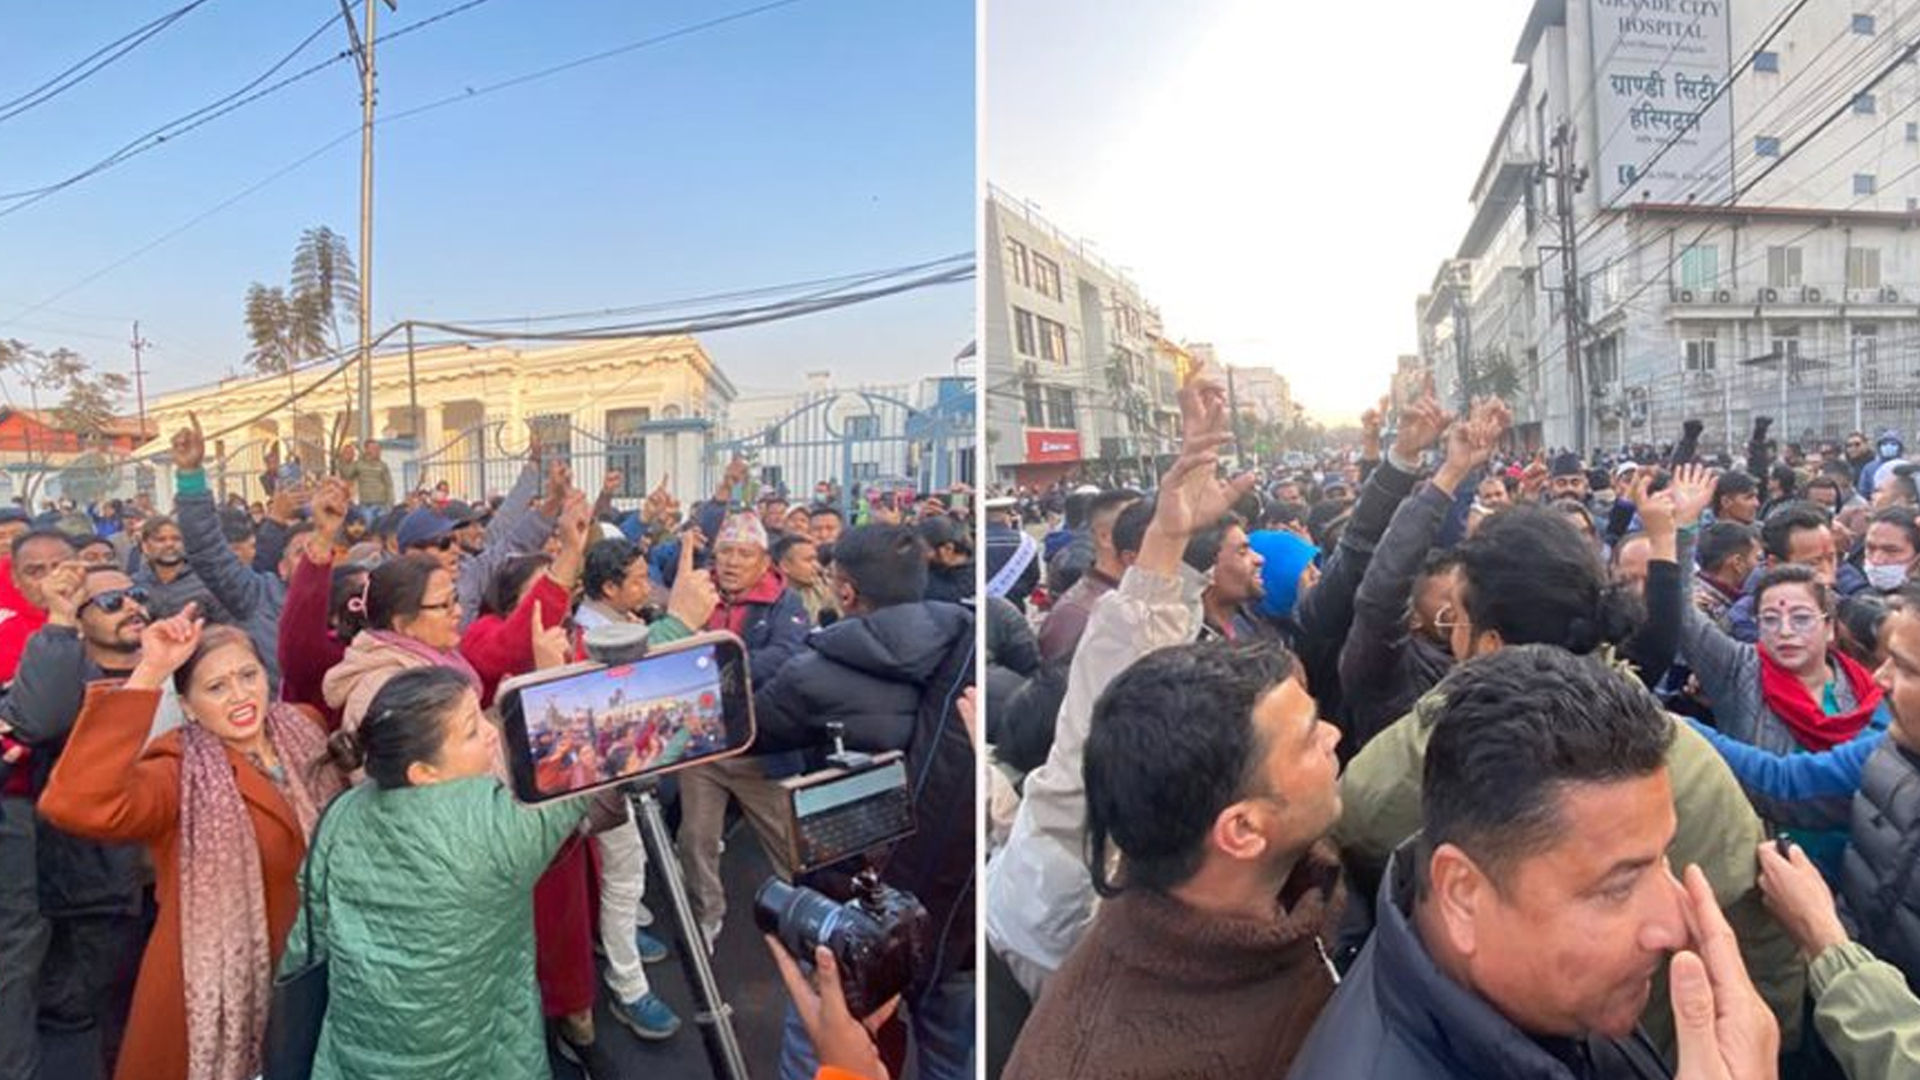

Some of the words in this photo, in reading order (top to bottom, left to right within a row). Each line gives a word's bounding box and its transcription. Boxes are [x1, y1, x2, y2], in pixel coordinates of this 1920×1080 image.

[1680, 0, 1719, 17] CITY
[1619, 18, 1707, 38] HOSPITAL
[1610, 70, 1665, 98] ग्राण्डी
[1674, 72, 1719, 101] सिटी
